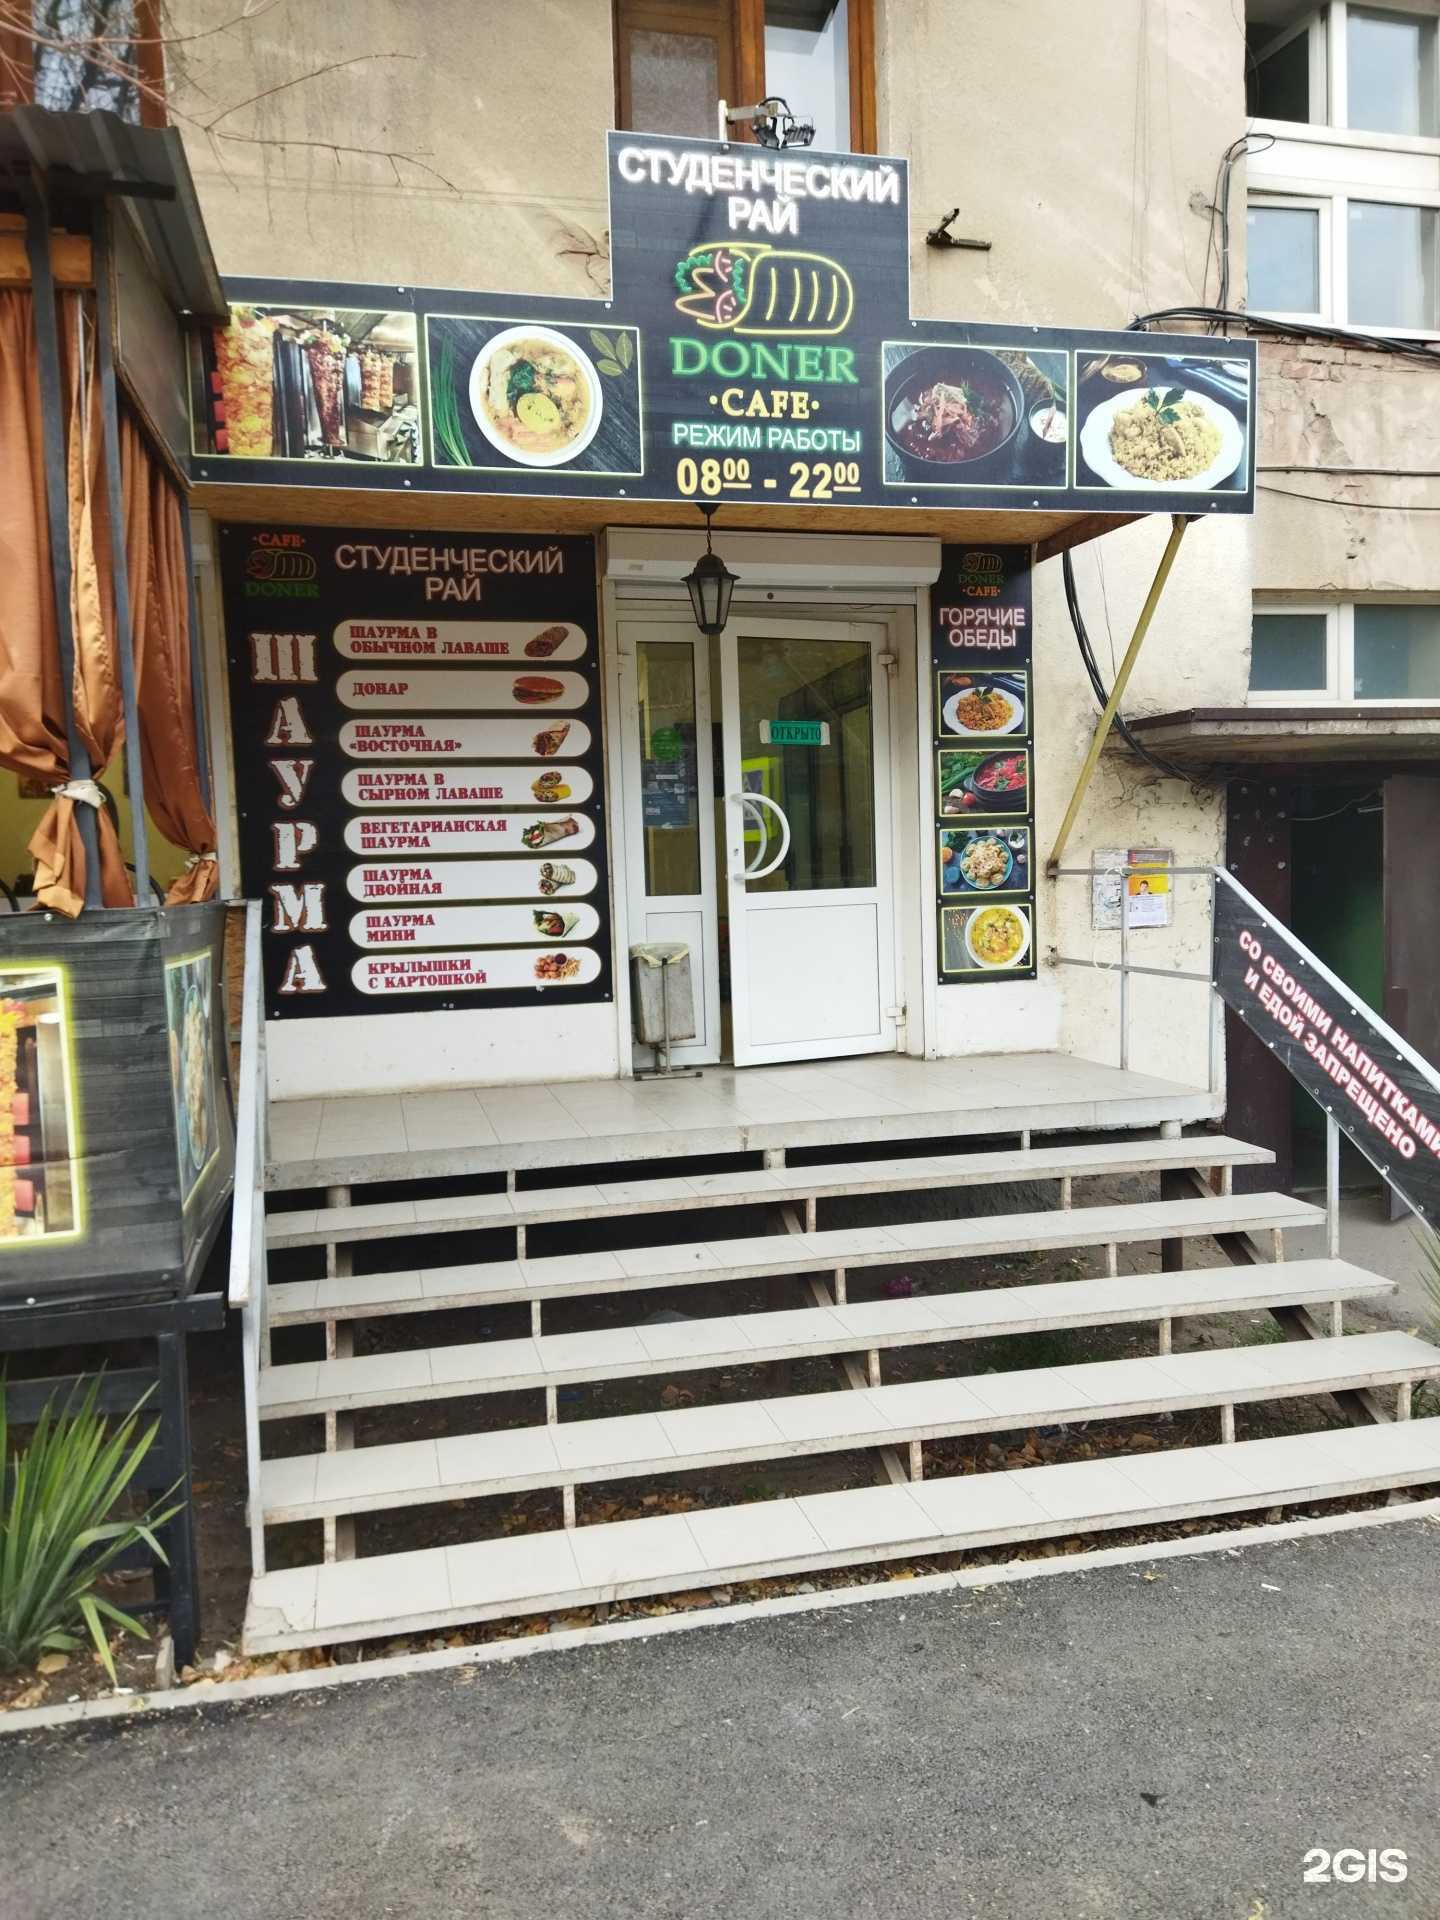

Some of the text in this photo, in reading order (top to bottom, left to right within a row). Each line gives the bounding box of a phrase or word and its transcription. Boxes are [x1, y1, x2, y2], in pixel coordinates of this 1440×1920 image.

[617, 147, 899, 204] СТУДЕНЧЕСКИЙ
[728, 196, 798, 235] РАЙ
[669, 337, 859, 383] DONER
[673, 423, 861, 452] РЕЖИМ РАБОТЫ
[335, 544, 565, 575] СТУДЕНЧЕСКИЙ
[425, 573, 481, 601] РАЙ
[958, 574, 1005, 585] DONER
[940, 607, 1026, 626] ГОРЯЧИЕ
[350, 626, 438, 639] ШАУРМА В
[949, 628, 1017, 650] ОБЕДЫ
[350, 641, 510, 655] ОБЫЧНОМ ЛАВАШЕ
[352, 683, 409, 697] ДОНАР
[355, 725, 425, 737] ШАУРМА
[771, 726, 822, 740] ОТКРЫТО
[350, 739, 462, 752] «ВОСТОЧНАЯ»
[357, 773, 444, 786] ШАУРМА В
[358, 787, 504, 800] СЫРНОМ ЛАВАШЕ
[360, 820, 507, 835] ВЕГЕТАРИАНСКАЯ
[361, 836, 431, 848] ШАУРМА
[363, 869, 432, 882] ШАУРМА
[363, 880, 442, 897] ДВОЙНАЯ
[366, 914, 435, 928] ШАУРМА
[366, 929, 416, 942] МИНИ
[368, 959, 472, 974] КРЫЛЫШКИ
[368, 969, 487, 989] С КАРТОШКОЙ
[1239, 930, 1262, 960] СО
[1262, 955, 1333, 1036] СВОИМИ
[1244, 967, 1416, 1158] И ЕДОЙ ЗАПРЕЩЕНО
